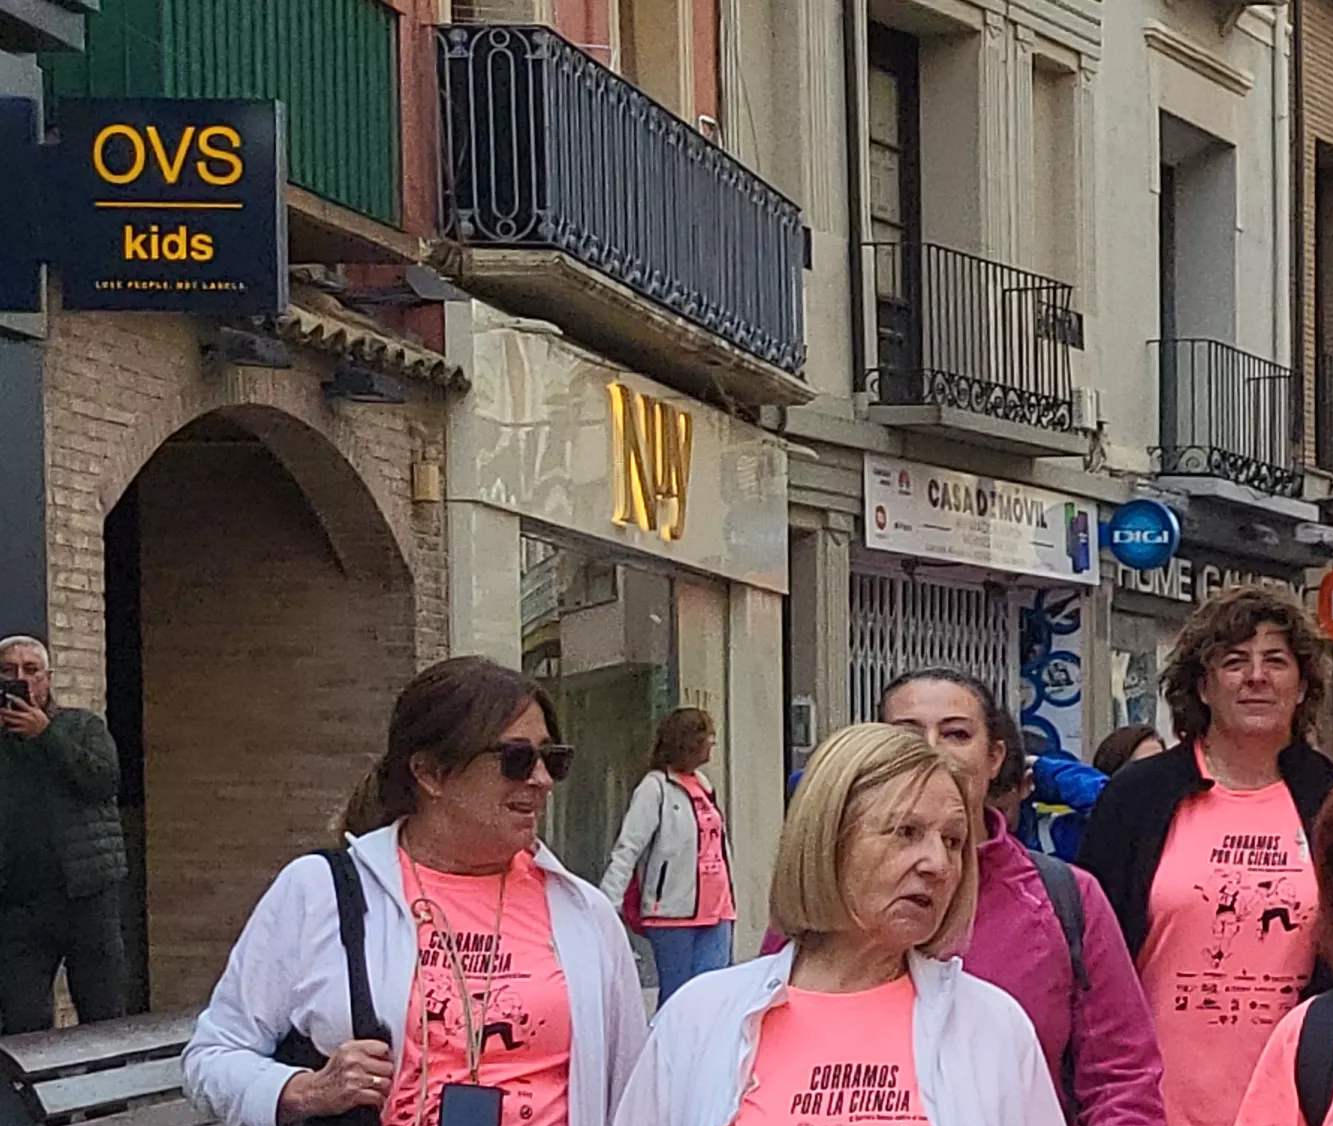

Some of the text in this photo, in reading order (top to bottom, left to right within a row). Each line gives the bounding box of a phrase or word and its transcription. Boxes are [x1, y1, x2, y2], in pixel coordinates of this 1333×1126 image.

[92, 123, 244, 186] OVS
[124, 225, 216, 262] kids
[928, 478, 974, 516] CASA
[999, 487, 1048, 529] MÓVIL
[1112, 530, 1169, 545] DIGI
[810, 1064, 899, 1091] CORRAMOS
[791, 1090, 910, 1117] POR LA CIENCIA
